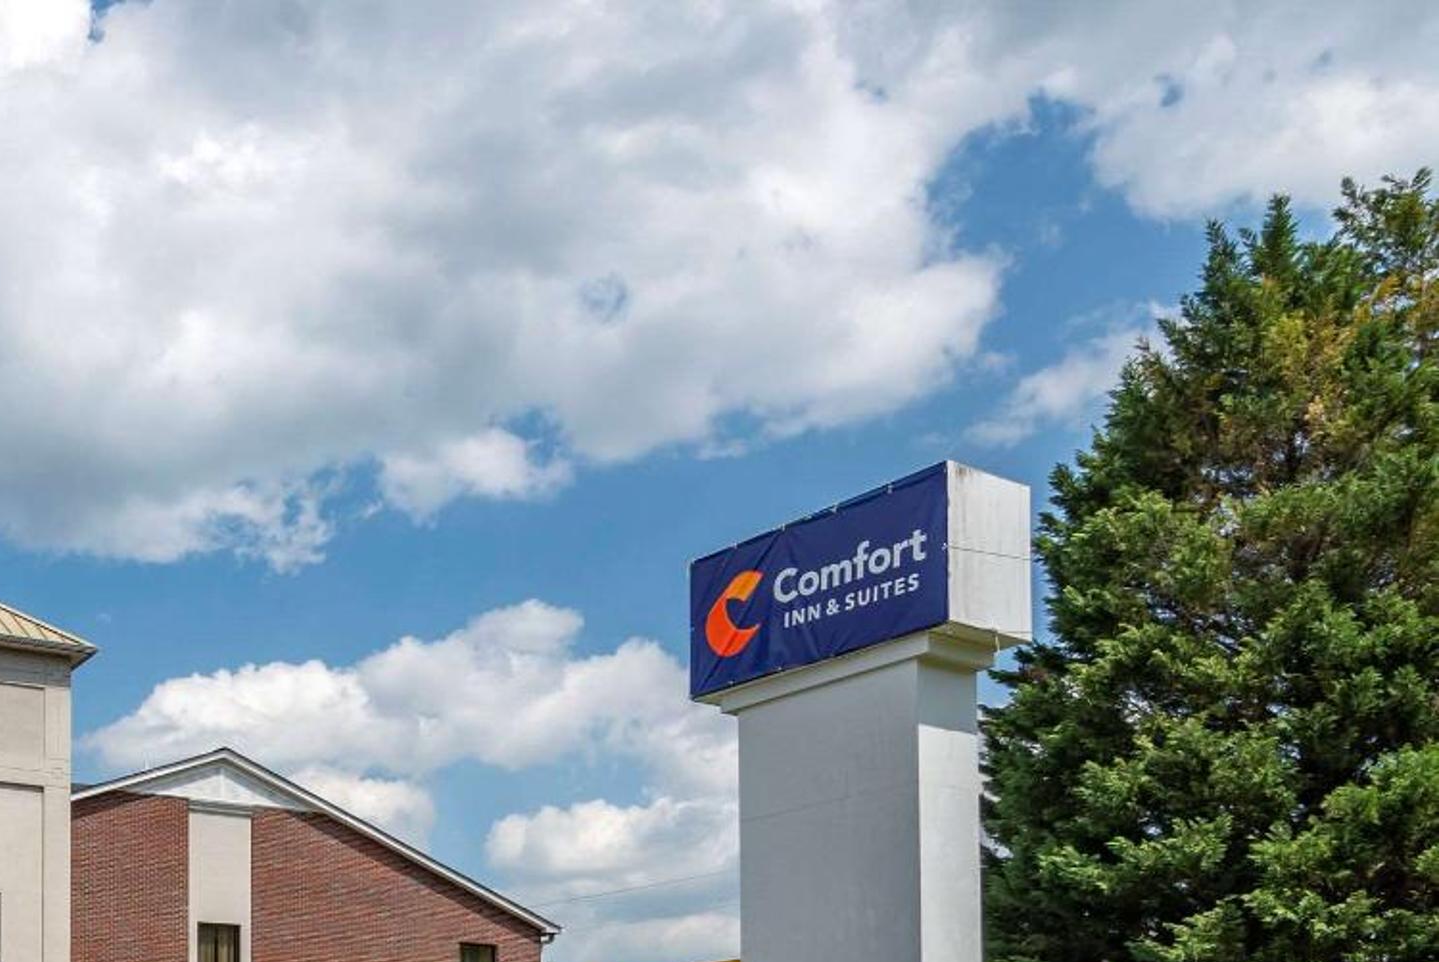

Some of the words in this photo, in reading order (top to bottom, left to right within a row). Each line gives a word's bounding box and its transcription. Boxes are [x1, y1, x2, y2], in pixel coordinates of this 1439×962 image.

[773, 528, 927, 603] Comfort
[783, 602, 821, 628] INN
[825, 597, 841, 616] &
[844, 573, 920, 612] SUITES
